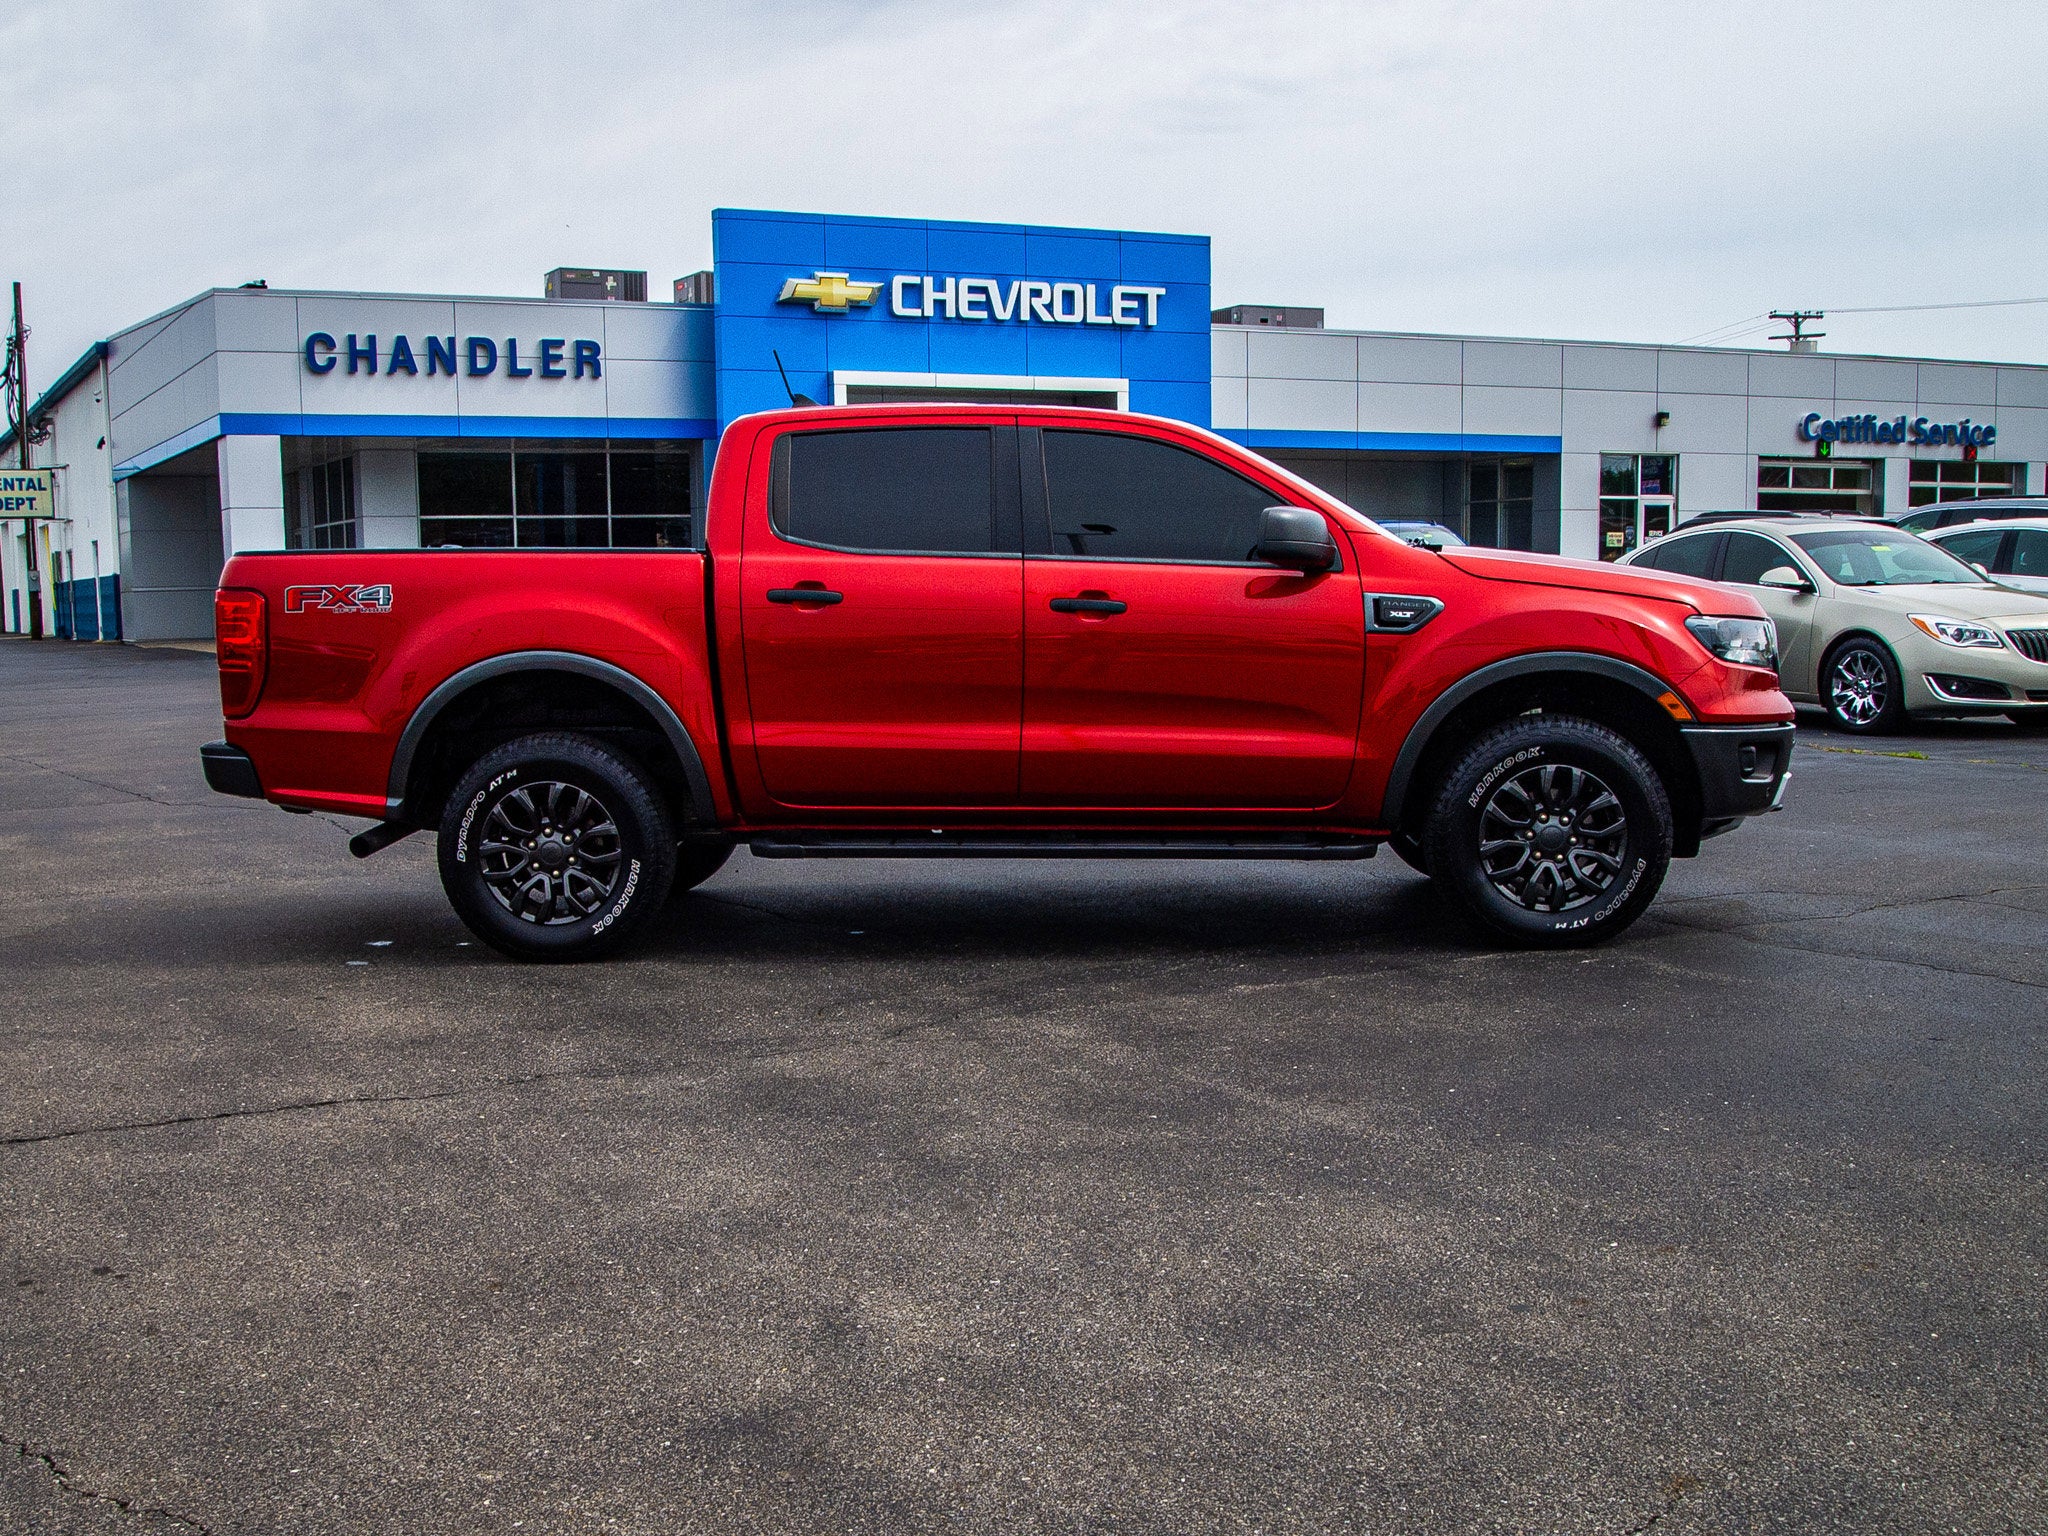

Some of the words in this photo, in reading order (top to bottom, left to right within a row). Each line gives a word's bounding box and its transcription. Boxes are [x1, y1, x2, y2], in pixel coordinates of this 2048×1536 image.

[891, 275, 1167, 327] CHEVROLET
[305, 332, 602, 379] CHANDLER
[1802, 412, 1907, 444] Certified
[1913, 416, 1997, 446] Service
[0, 477, 47, 491] NTAL
[285, 584, 393, 613] FX4
